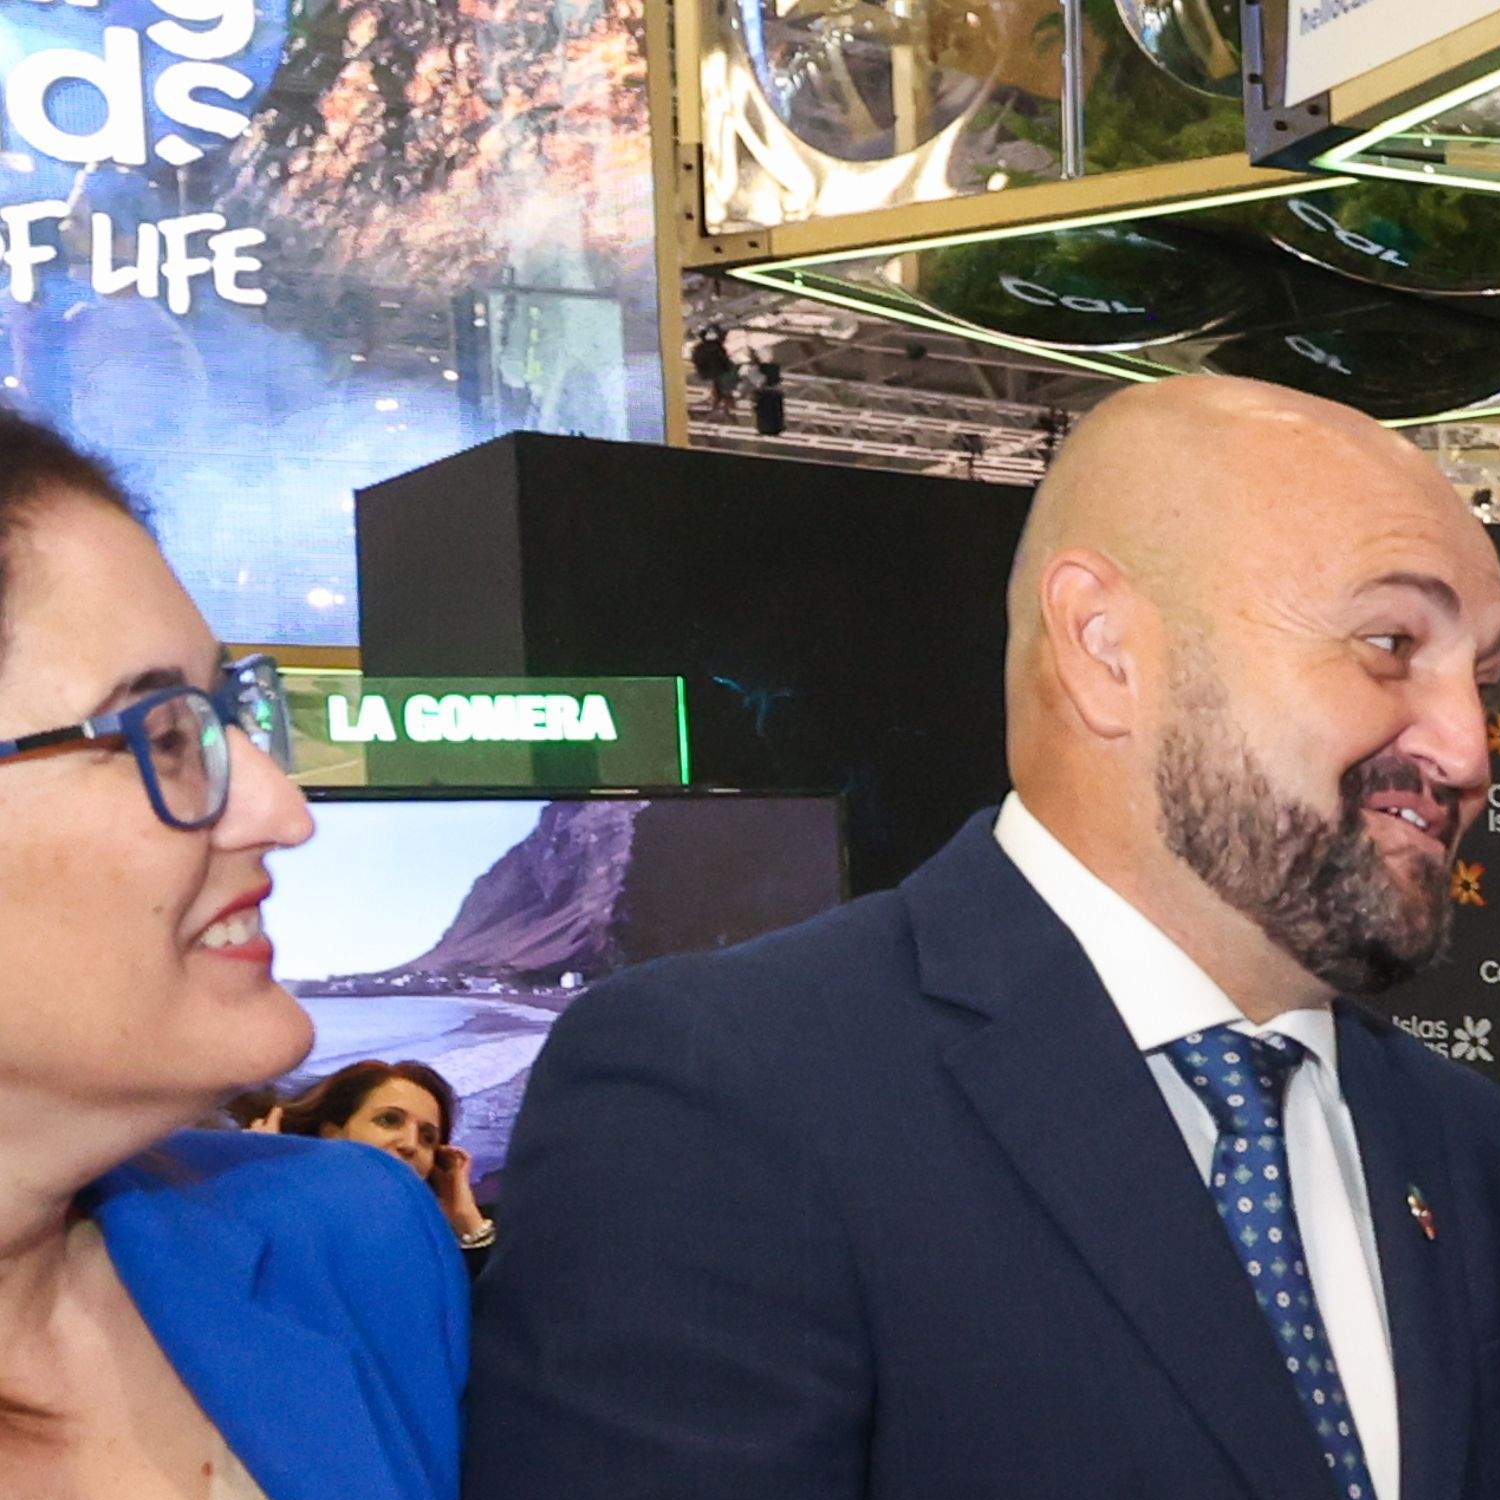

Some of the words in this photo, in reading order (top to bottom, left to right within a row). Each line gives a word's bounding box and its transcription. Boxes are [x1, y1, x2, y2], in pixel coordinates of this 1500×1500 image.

[0, 200, 71, 303] F
[91, 212, 268, 315] LIFE
[327, 694, 398, 742] LA
[403, 694, 618, 742] GOMERA
